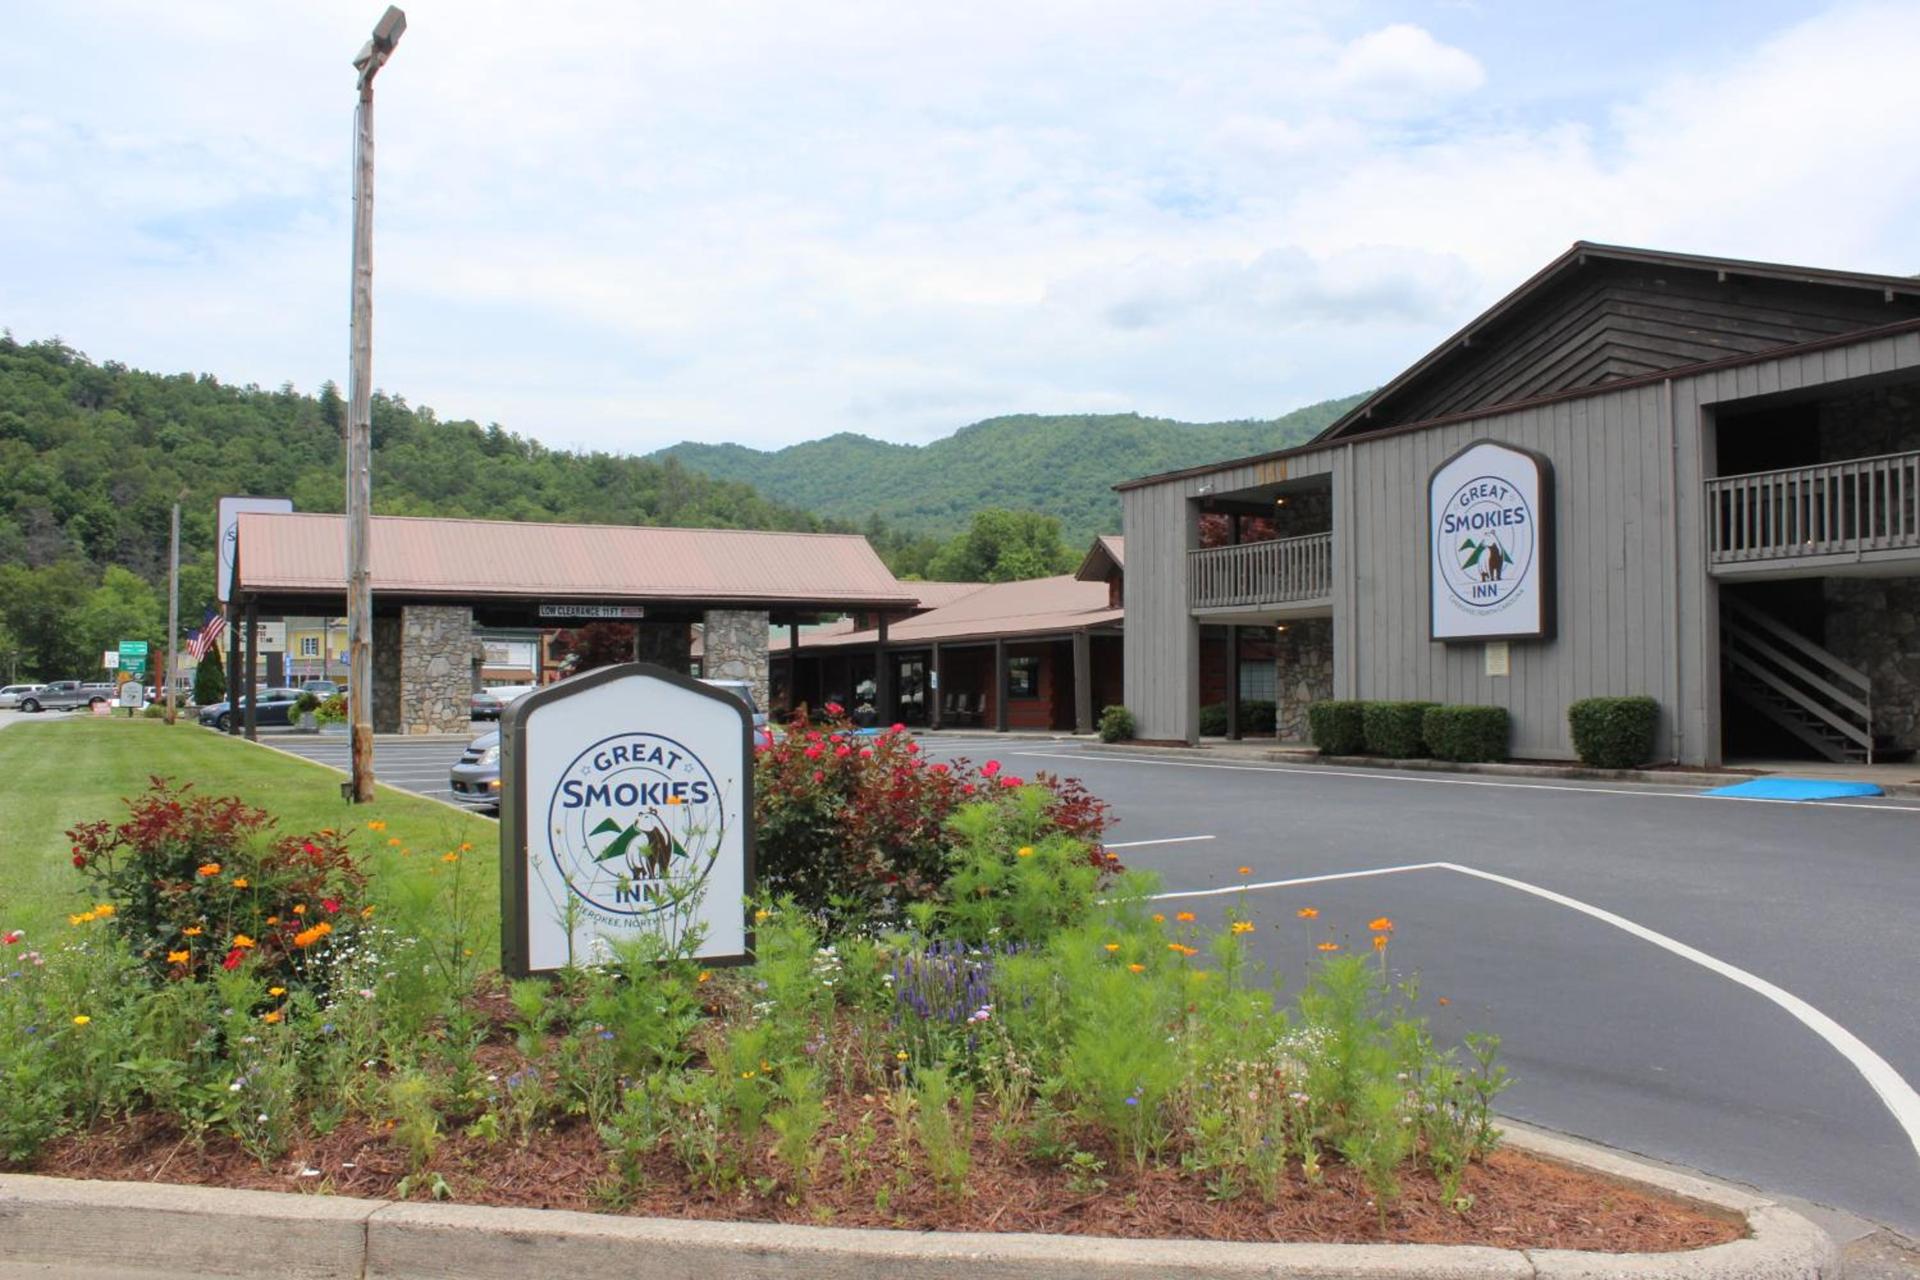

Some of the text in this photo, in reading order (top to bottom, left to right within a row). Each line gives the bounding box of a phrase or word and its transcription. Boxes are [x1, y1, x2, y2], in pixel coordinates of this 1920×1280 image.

[1460, 484, 1508, 506] GREAT
[1444, 507, 1525, 534] SMOKIES
[1472, 583, 1498, 599] INN
[594, 744, 682, 771] GREAT
[563, 780, 708, 808] SMOKIES
[615, 883, 661, 904] INN
